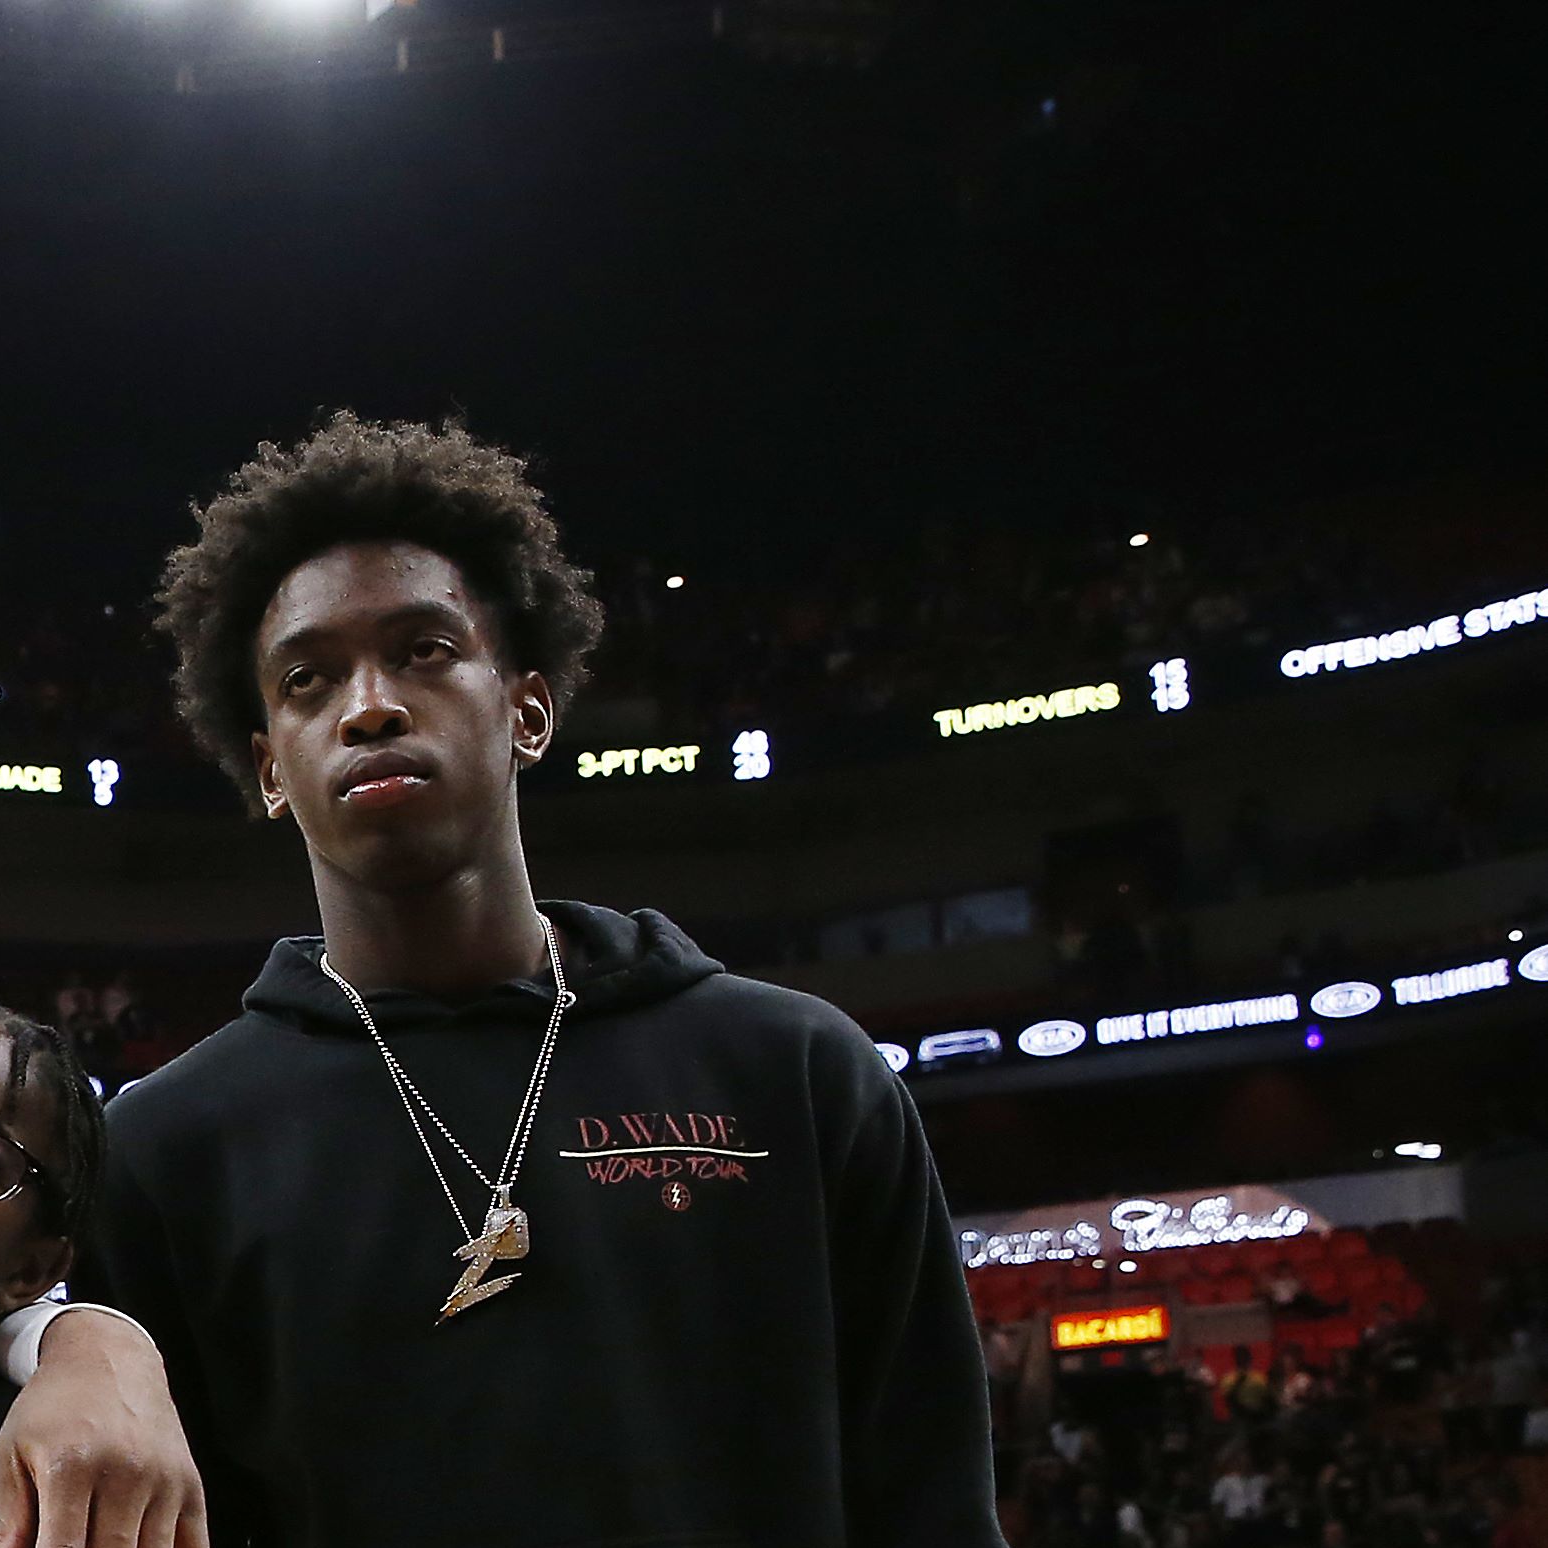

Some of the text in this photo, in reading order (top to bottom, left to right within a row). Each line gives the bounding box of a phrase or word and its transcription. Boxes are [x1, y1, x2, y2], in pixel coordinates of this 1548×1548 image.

[1280, 615, 1462, 678] OFFENSIVE
[933, 682, 1121, 737] TURNOVERS
[87, 758, 120, 786] 13
[577, 744, 701, 779] 3-PT PCT
[585, 1156, 749, 1185] WORLD TOUR
